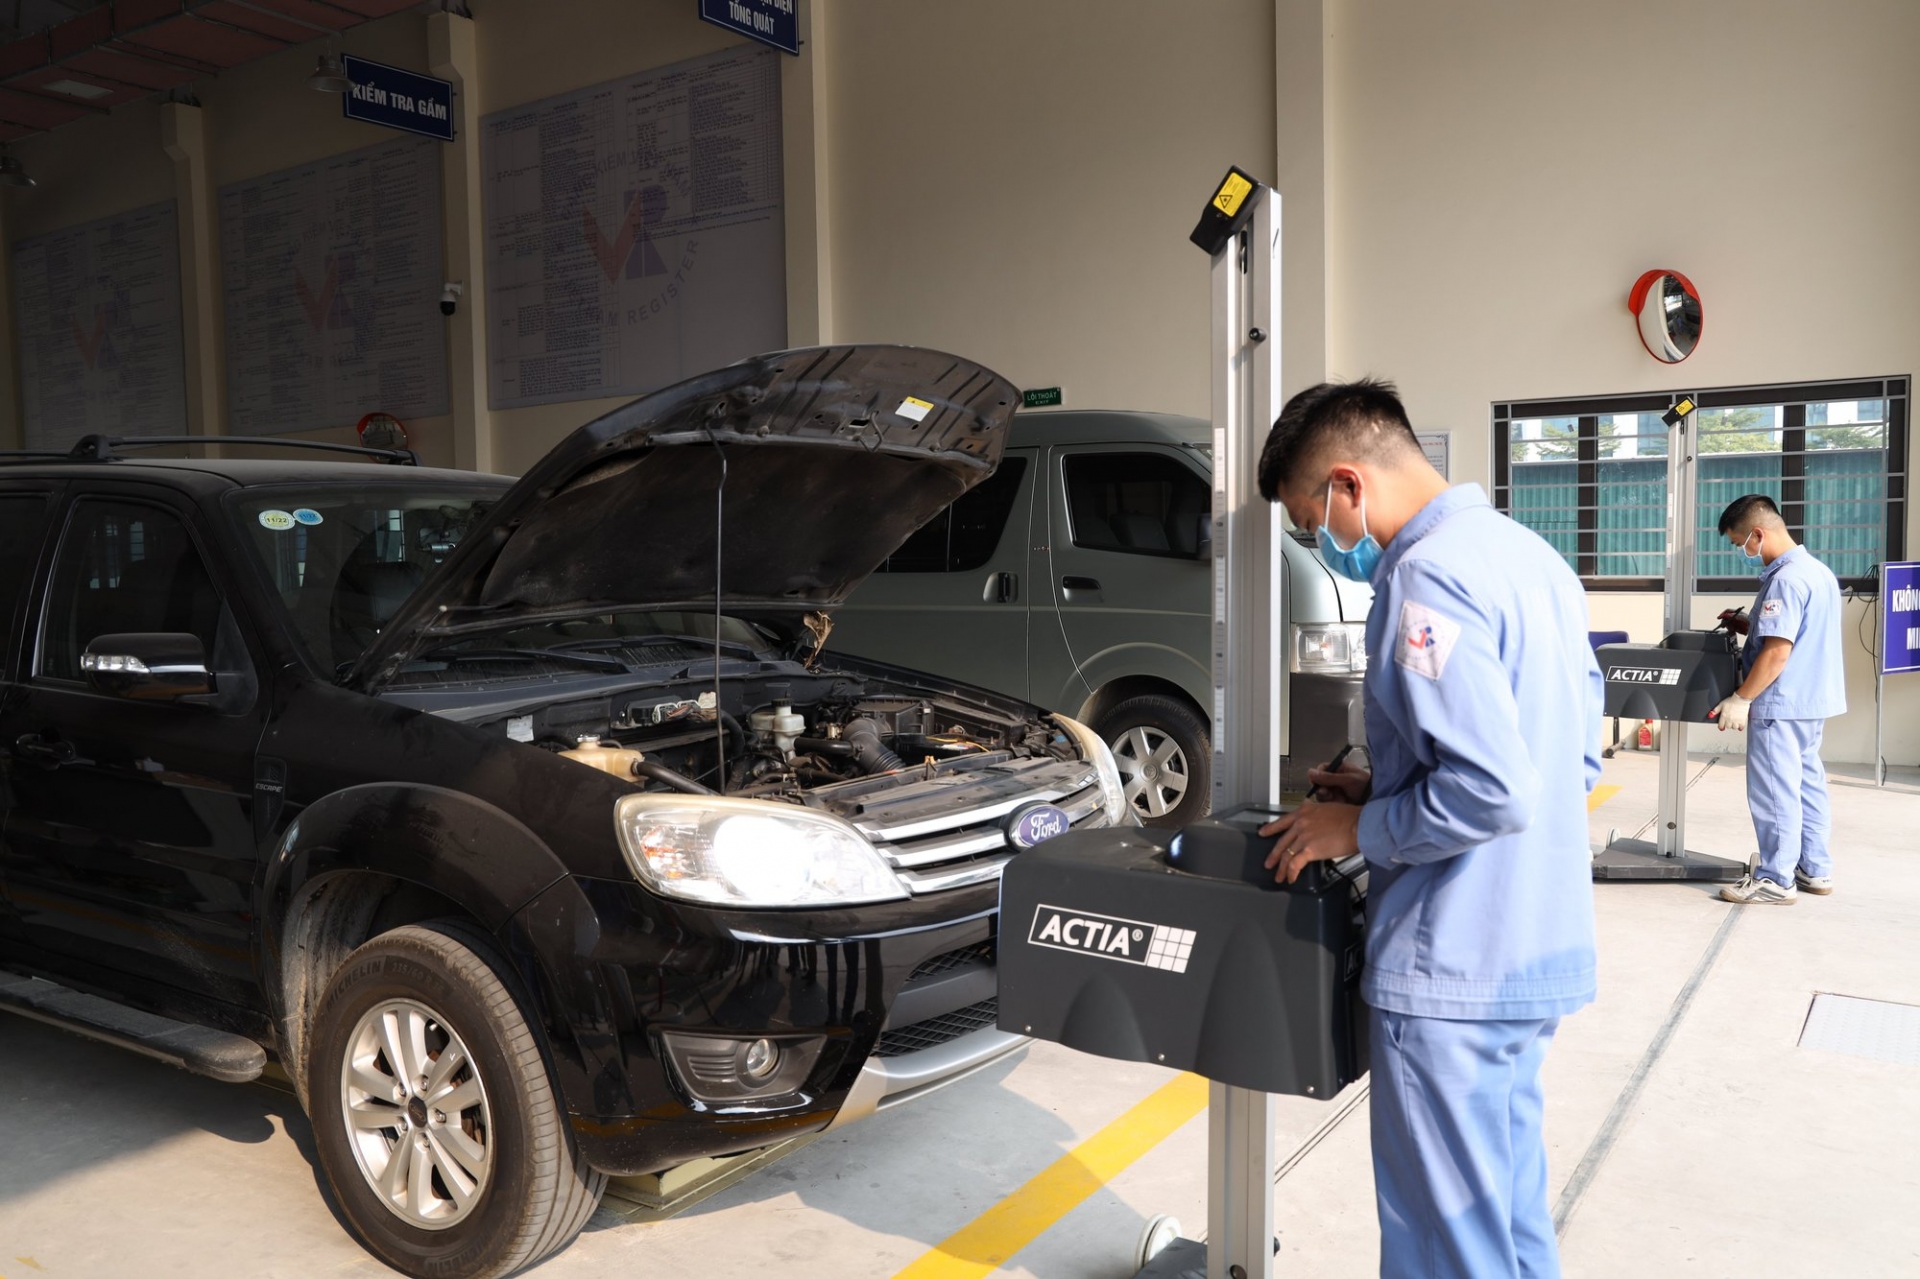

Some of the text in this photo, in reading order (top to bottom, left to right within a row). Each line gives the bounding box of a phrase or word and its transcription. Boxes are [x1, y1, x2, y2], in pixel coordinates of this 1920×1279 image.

[753, 12, 775, 35] QUÁT
[389, 92, 415, 113] TRA
[1892, 584, 1920, 612] KHÔN
[255, 782, 283, 792] ESCAPE
[1030, 812, 1062, 841] Ford
[325, 960, 382, 1012] MICHELIN
